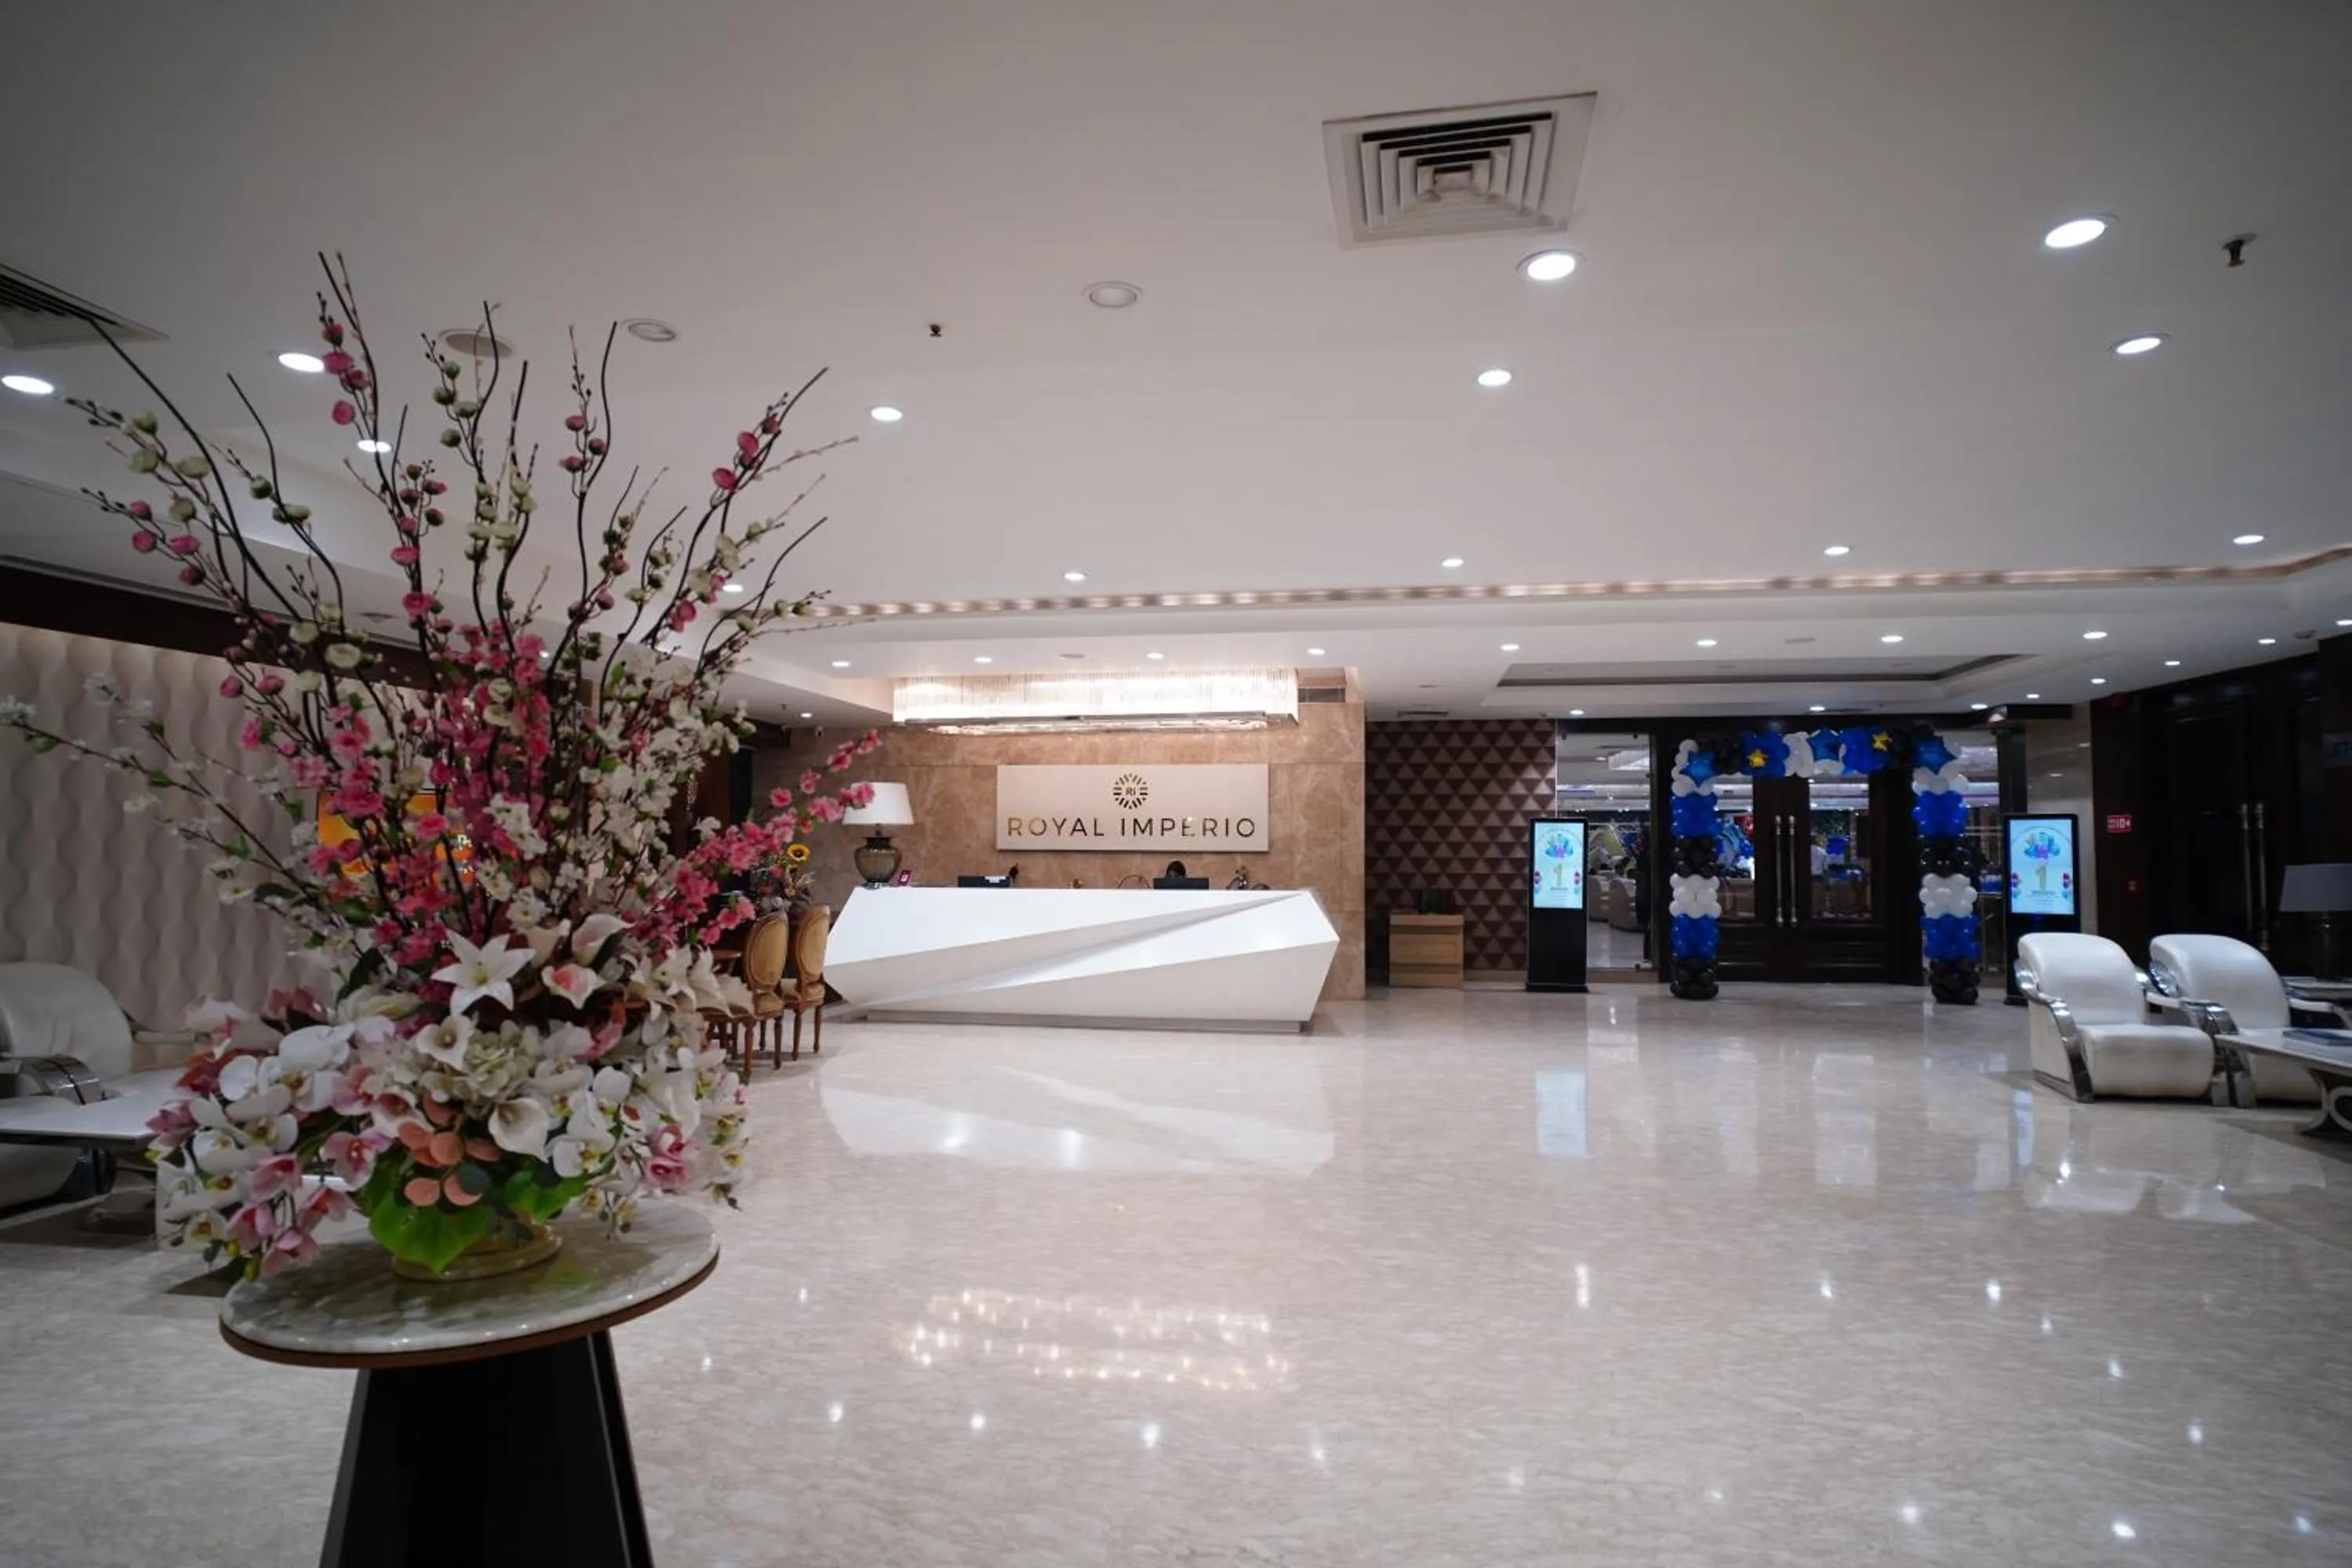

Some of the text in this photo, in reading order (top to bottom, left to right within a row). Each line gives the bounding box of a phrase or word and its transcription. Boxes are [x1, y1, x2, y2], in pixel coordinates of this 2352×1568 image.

[1126, 787, 1136, 796] RI
[1007, 817, 1255, 837] ROYAL IMPERIO
